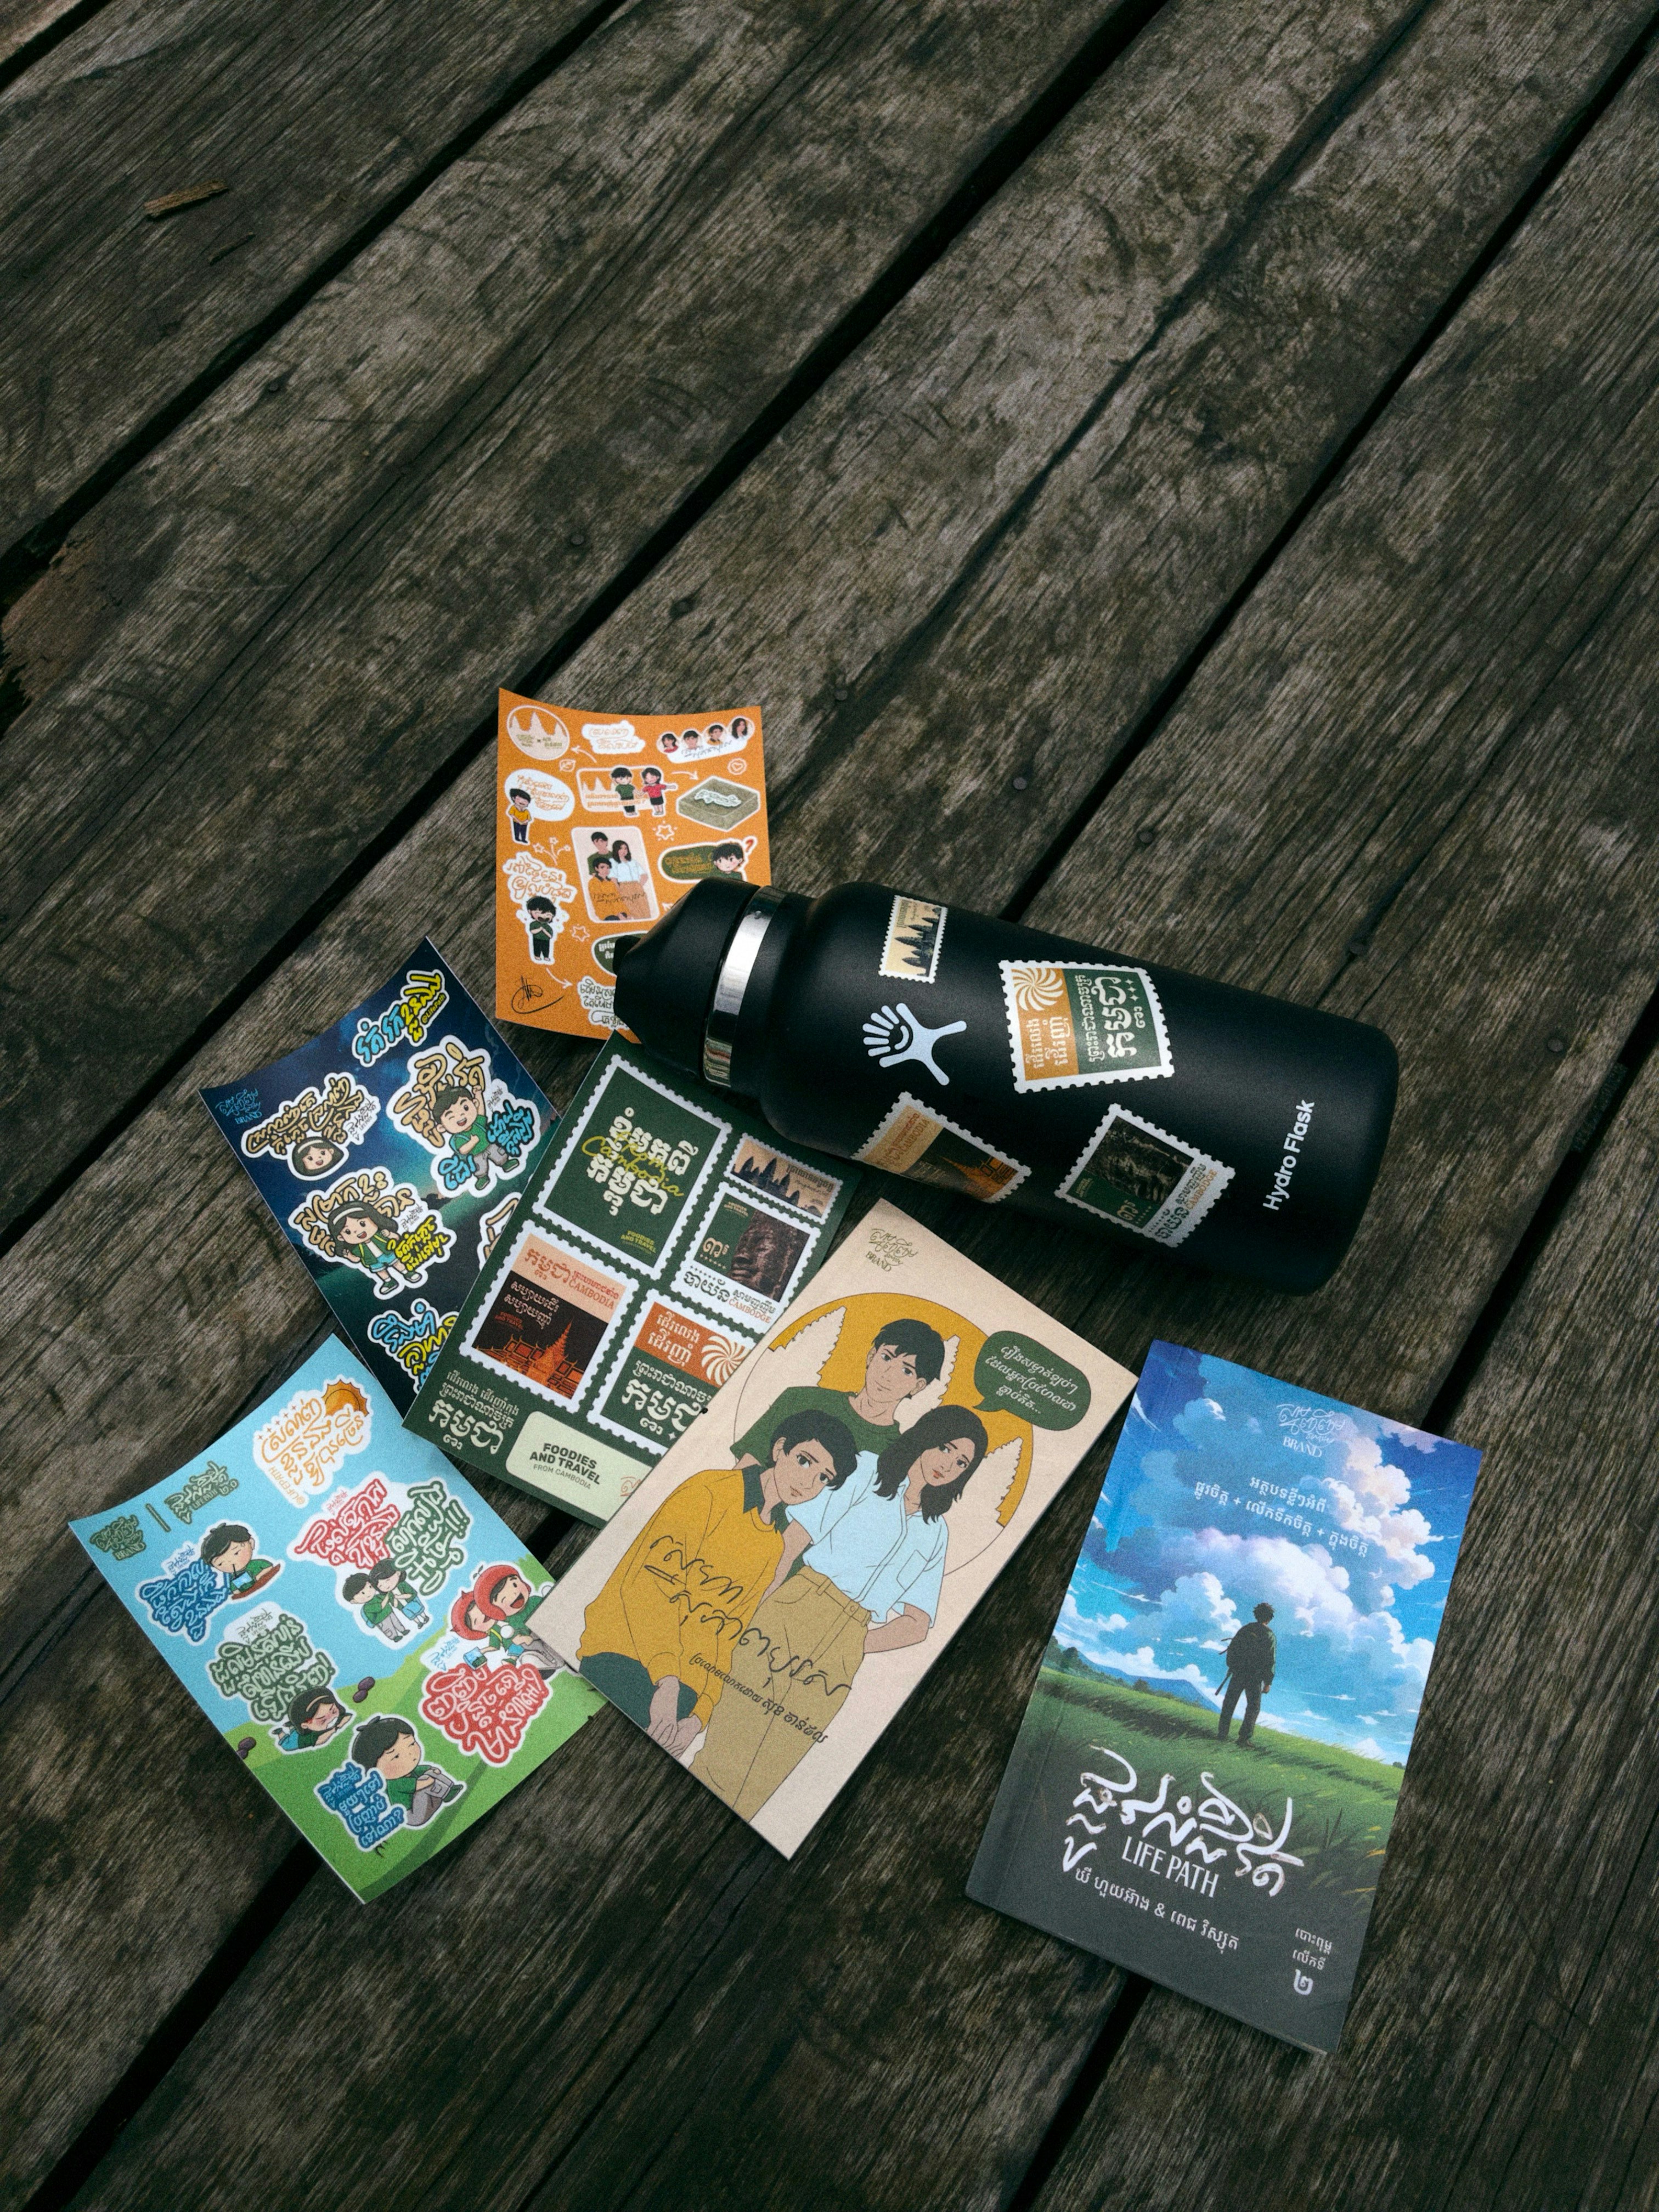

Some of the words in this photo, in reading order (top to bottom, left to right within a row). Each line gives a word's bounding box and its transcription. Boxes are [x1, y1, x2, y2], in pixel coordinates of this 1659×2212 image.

[234, 1110, 262, 1125] BRAND
[581, 1134, 684, 1198] Cambodia
[1262, 1156, 1297, 1211] Hydro
[1284, 1099, 1315, 1153] Flask
[1186, 1169, 1217, 1210] CAMBODGE
[627, 1230, 654, 1245] FOODIES
[634, 1238, 656, 1253] TRAVEL
[866, 1251, 892, 1271] BRAND
[568, 1279, 615, 1309] CAMBODIA
[727, 1298, 772, 1324] CAMBODGE
[543, 1443, 597, 1469] FOODIES
[1283, 1437, 1323, 1458] BRAND
[529, 1451, 555, 1464] AND
[558, 1457, 600, 1485] TRAVEL
[533, 1464, 554, 1472] FROM
[555, 1468, 590, 1489] CAMBODIA
[1233, 1497, 1242, 1506] +
[114, 1539, 145, 1561] BRAND
[1121, 1836, 1164, 1876] LIFE
[1165, 1853, 1220, 1899] PATH
[1154, 1904, 1165, 1918] &
[1293, 1949, 1325, 1971] លើកទី
[1293, 1969, 1314, 1996] ២
